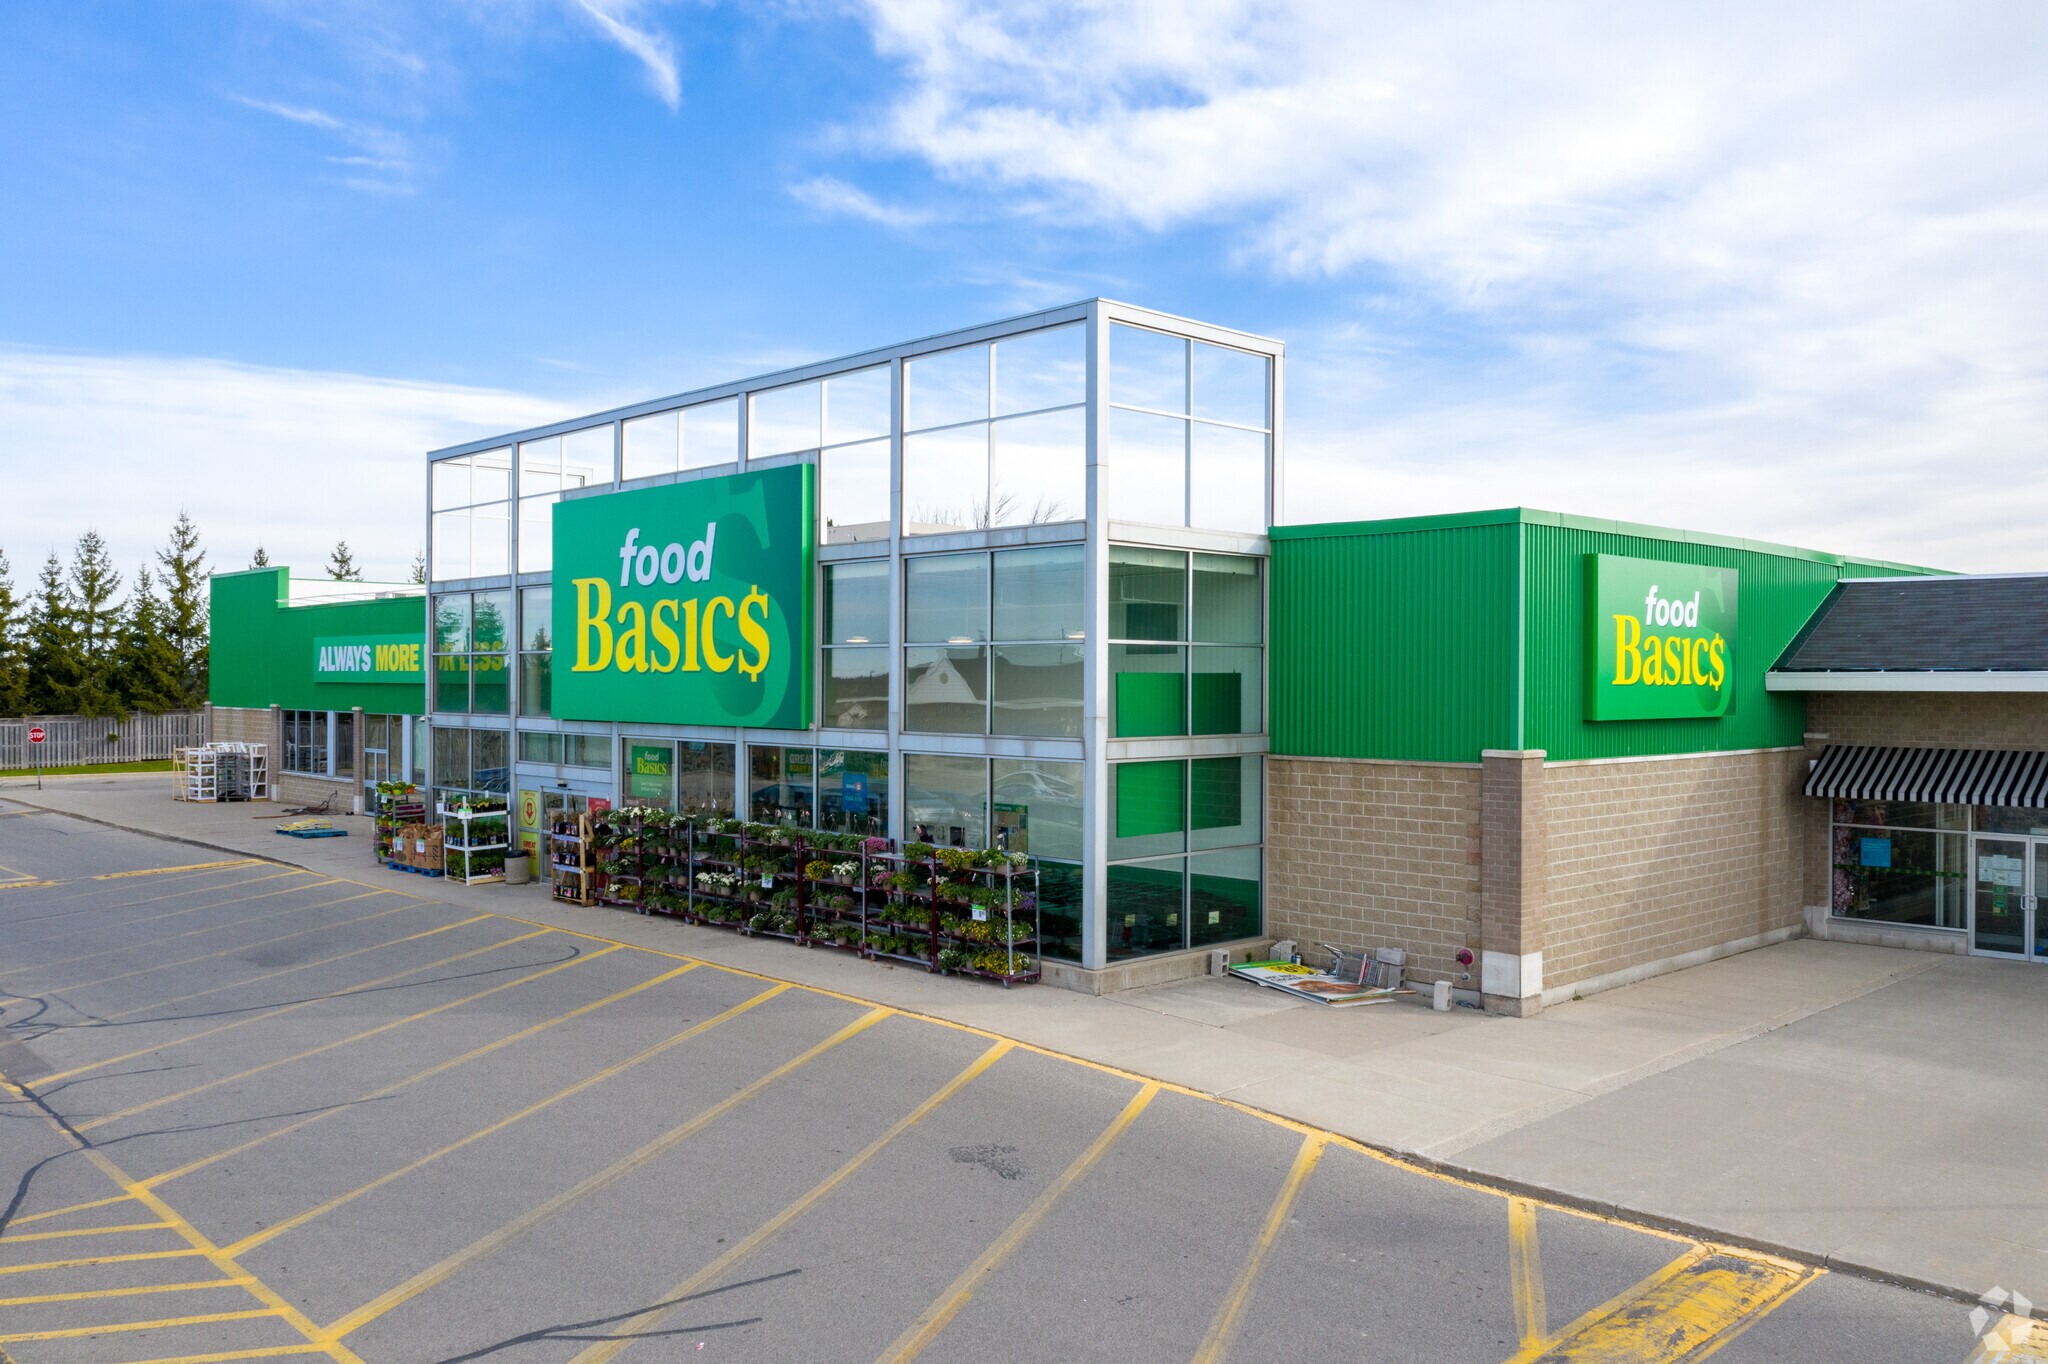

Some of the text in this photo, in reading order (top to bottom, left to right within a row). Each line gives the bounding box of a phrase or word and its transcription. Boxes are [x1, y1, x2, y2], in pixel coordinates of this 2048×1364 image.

[619, 522, 716, 586] food
[1645, 585, 1700, 628] food
[318, 645, 371, 672] ALWAYS
[375, 643, 419, 672] MORE
[644, 751, 659, 761] food
